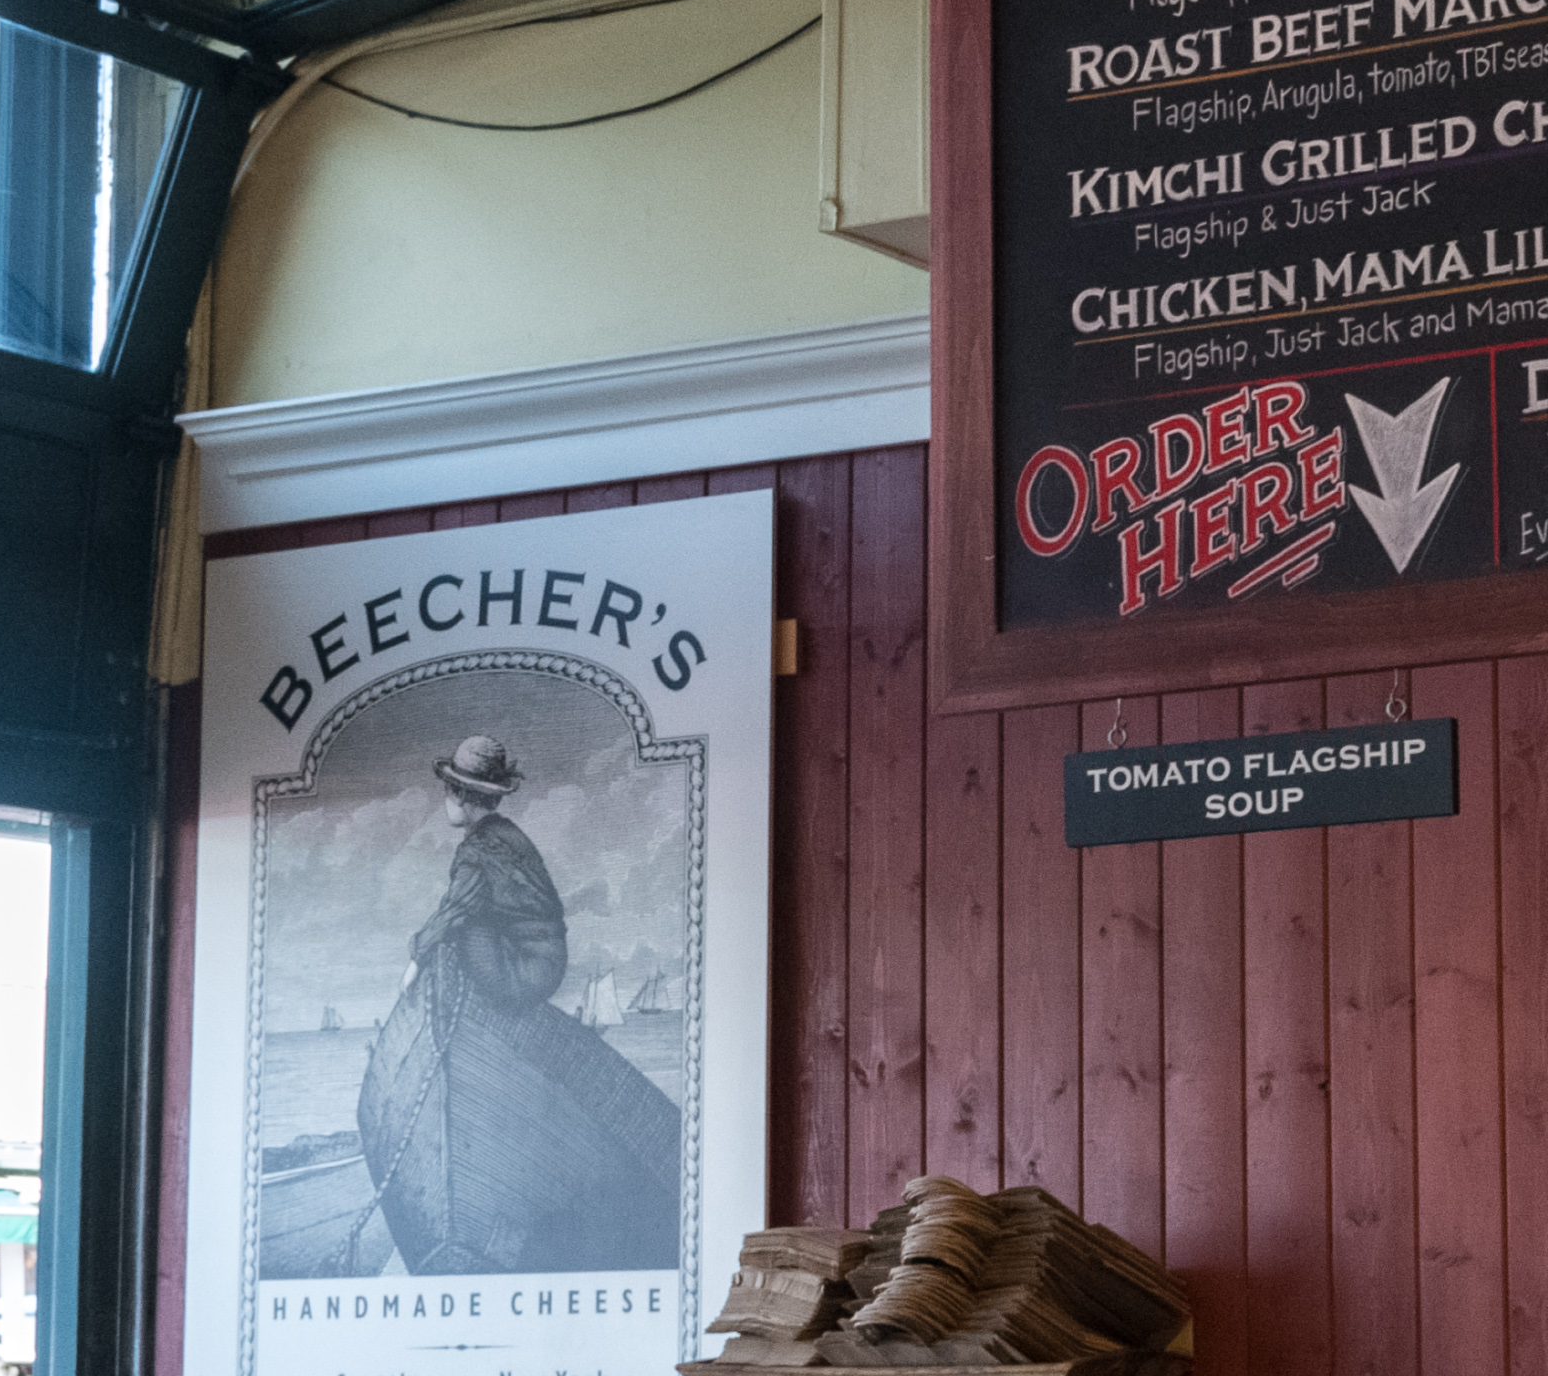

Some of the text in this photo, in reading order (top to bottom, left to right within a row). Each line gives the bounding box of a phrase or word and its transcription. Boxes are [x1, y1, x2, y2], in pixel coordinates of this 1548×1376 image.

[1067, 25, 1233, 94] ROAST
[1252, 0, 1375, 61] BEEF
[1067, 153, 1245, 217] KIMCHI
[1260, 113, 1477, 190] GRILLED
[1015, 381, 1314, 557] ORDER
[1119, 427, 1346, 615] HERE
[260, 568, 708, 732] BEECHER'S
[1086, 737, 1427, 794] TOMATO FLAGSHIP
[1204, 785, 1305, 821] SOUP
[273, 1288, 662, 1321] HANDMADE CHEESE
